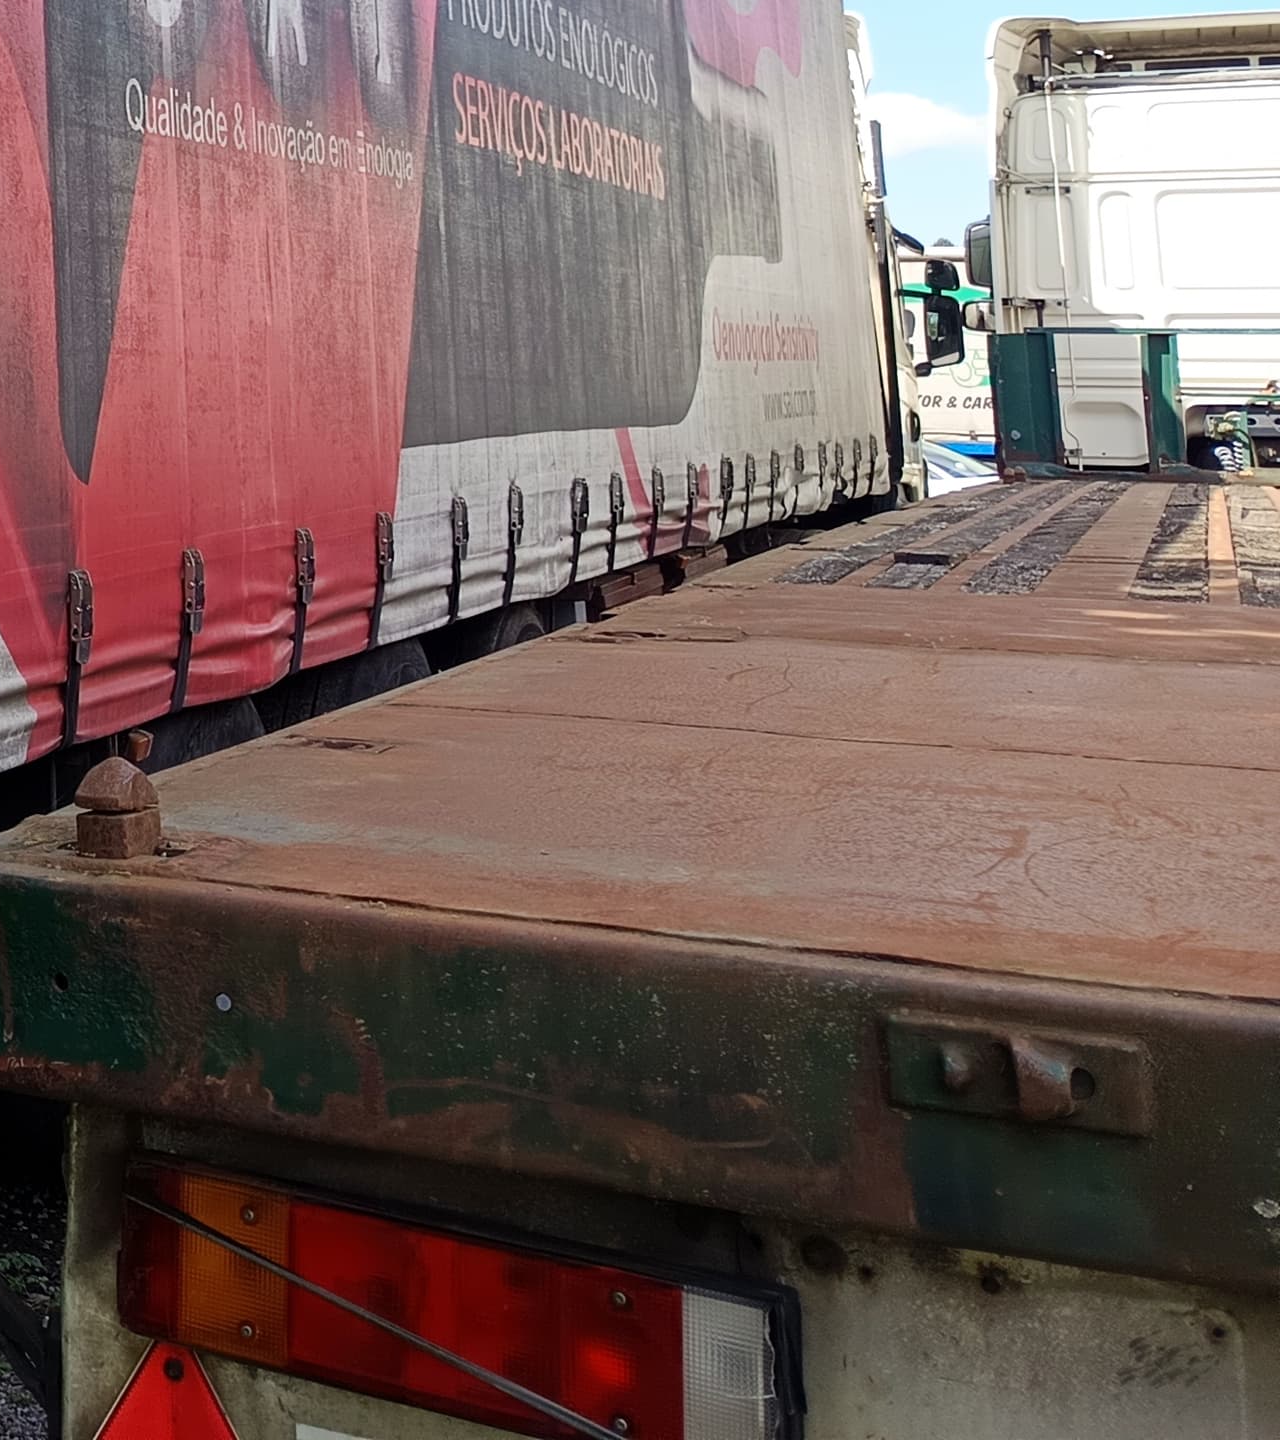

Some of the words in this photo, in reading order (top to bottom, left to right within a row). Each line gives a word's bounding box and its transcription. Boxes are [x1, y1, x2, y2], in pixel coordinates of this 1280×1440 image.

[558, 7, 658, 108] ENOLÓGICOS
[125, 77, 227, 149] Qualidade
[233, 101, 247, 152] &
[252, 106, 325, 172] Inovação
[329, 135, 351, 169] em
[356, 130, 414, 190] Enologia
[453, 72, 547, 176] SERVIÇOS
[548, 105, 665, 201] LABORATORIAIS
[712, 305, 774, 376] Oenological
[946, 396, 957, 408] &
